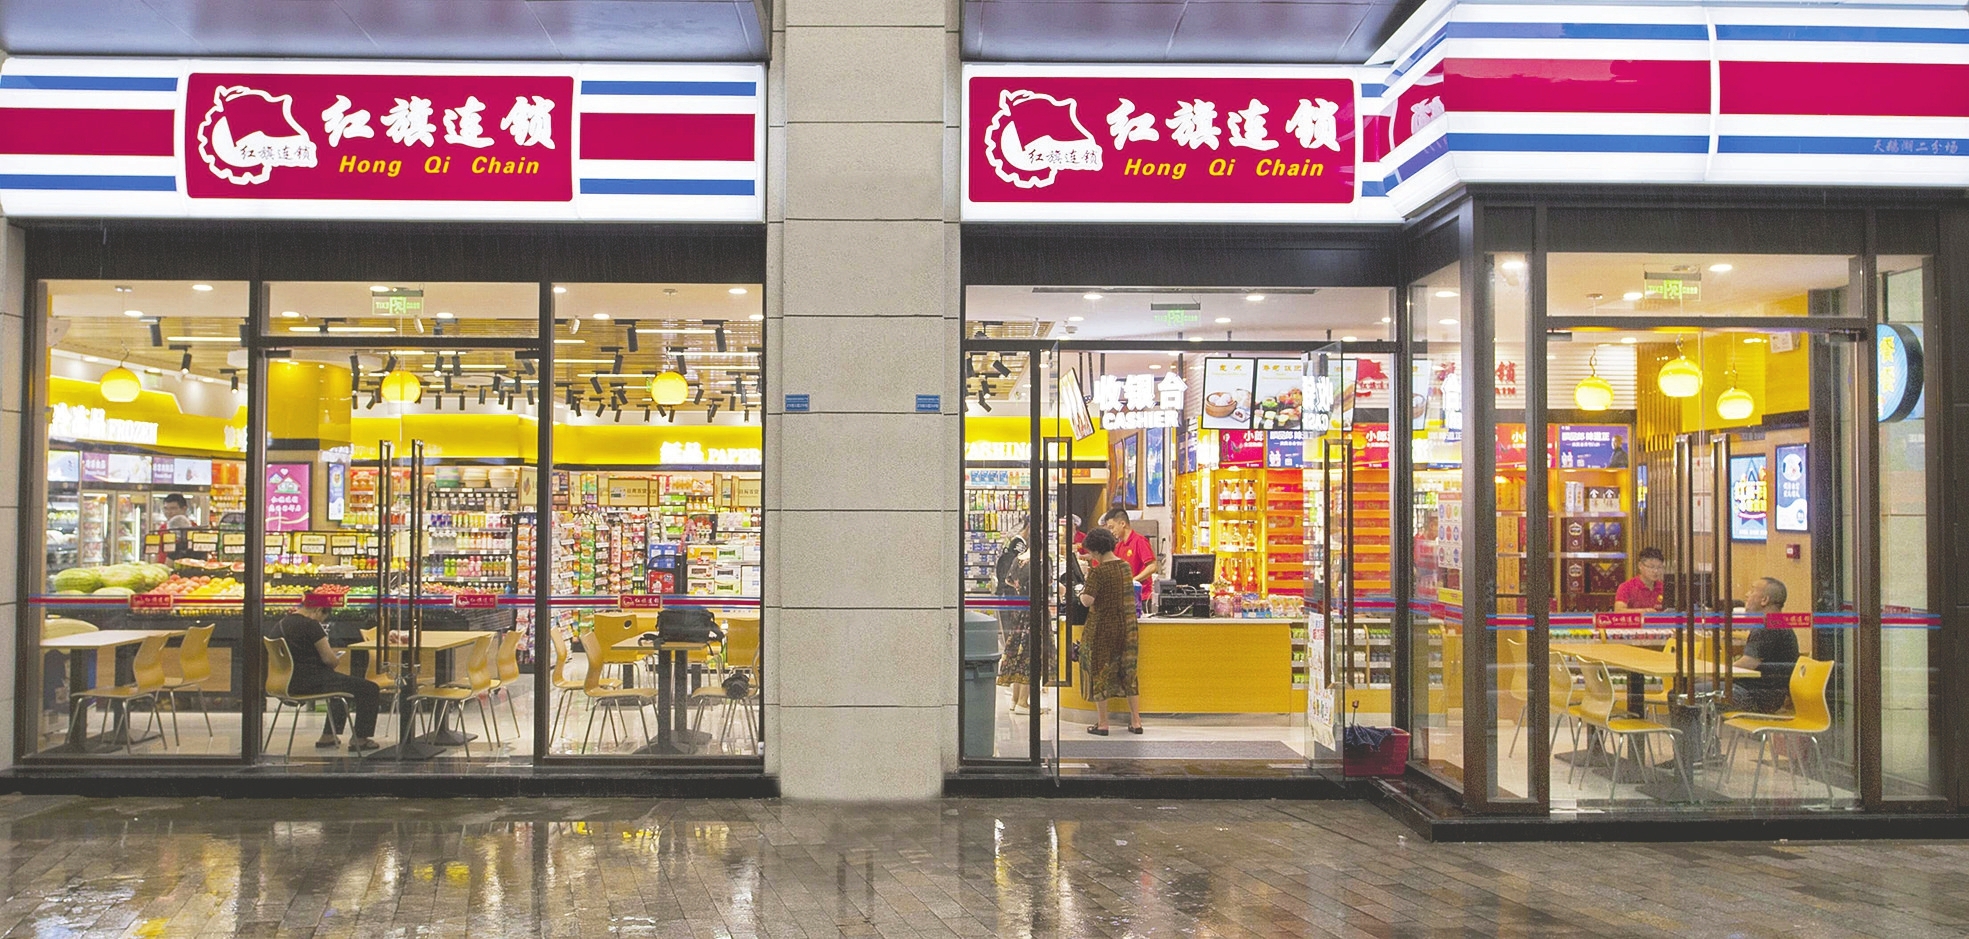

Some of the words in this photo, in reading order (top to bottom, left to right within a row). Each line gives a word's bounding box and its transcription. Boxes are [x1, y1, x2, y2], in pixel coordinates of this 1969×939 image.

[322, 95, 556, 149] 红旗连锁
[1106, 97, 1341, 151] 红旗连锁
[239, 145, 312, 161] 红旗连锁
[1028, 149, 1098, 165] 红旗连锁
[338, 155, 402, 178] Hong
[424, 155, 450, 174] Qi
[471, 156, 540, 174] Chain
[1123, 158, 1187, 180] Hong
[1208, 158, 1236, 177] Qi
[1255, 158, 1325, 177] Chain
[1093, 371, 1189, 411] 收银台
[1102, 410, 1180, 430] CASHIER
